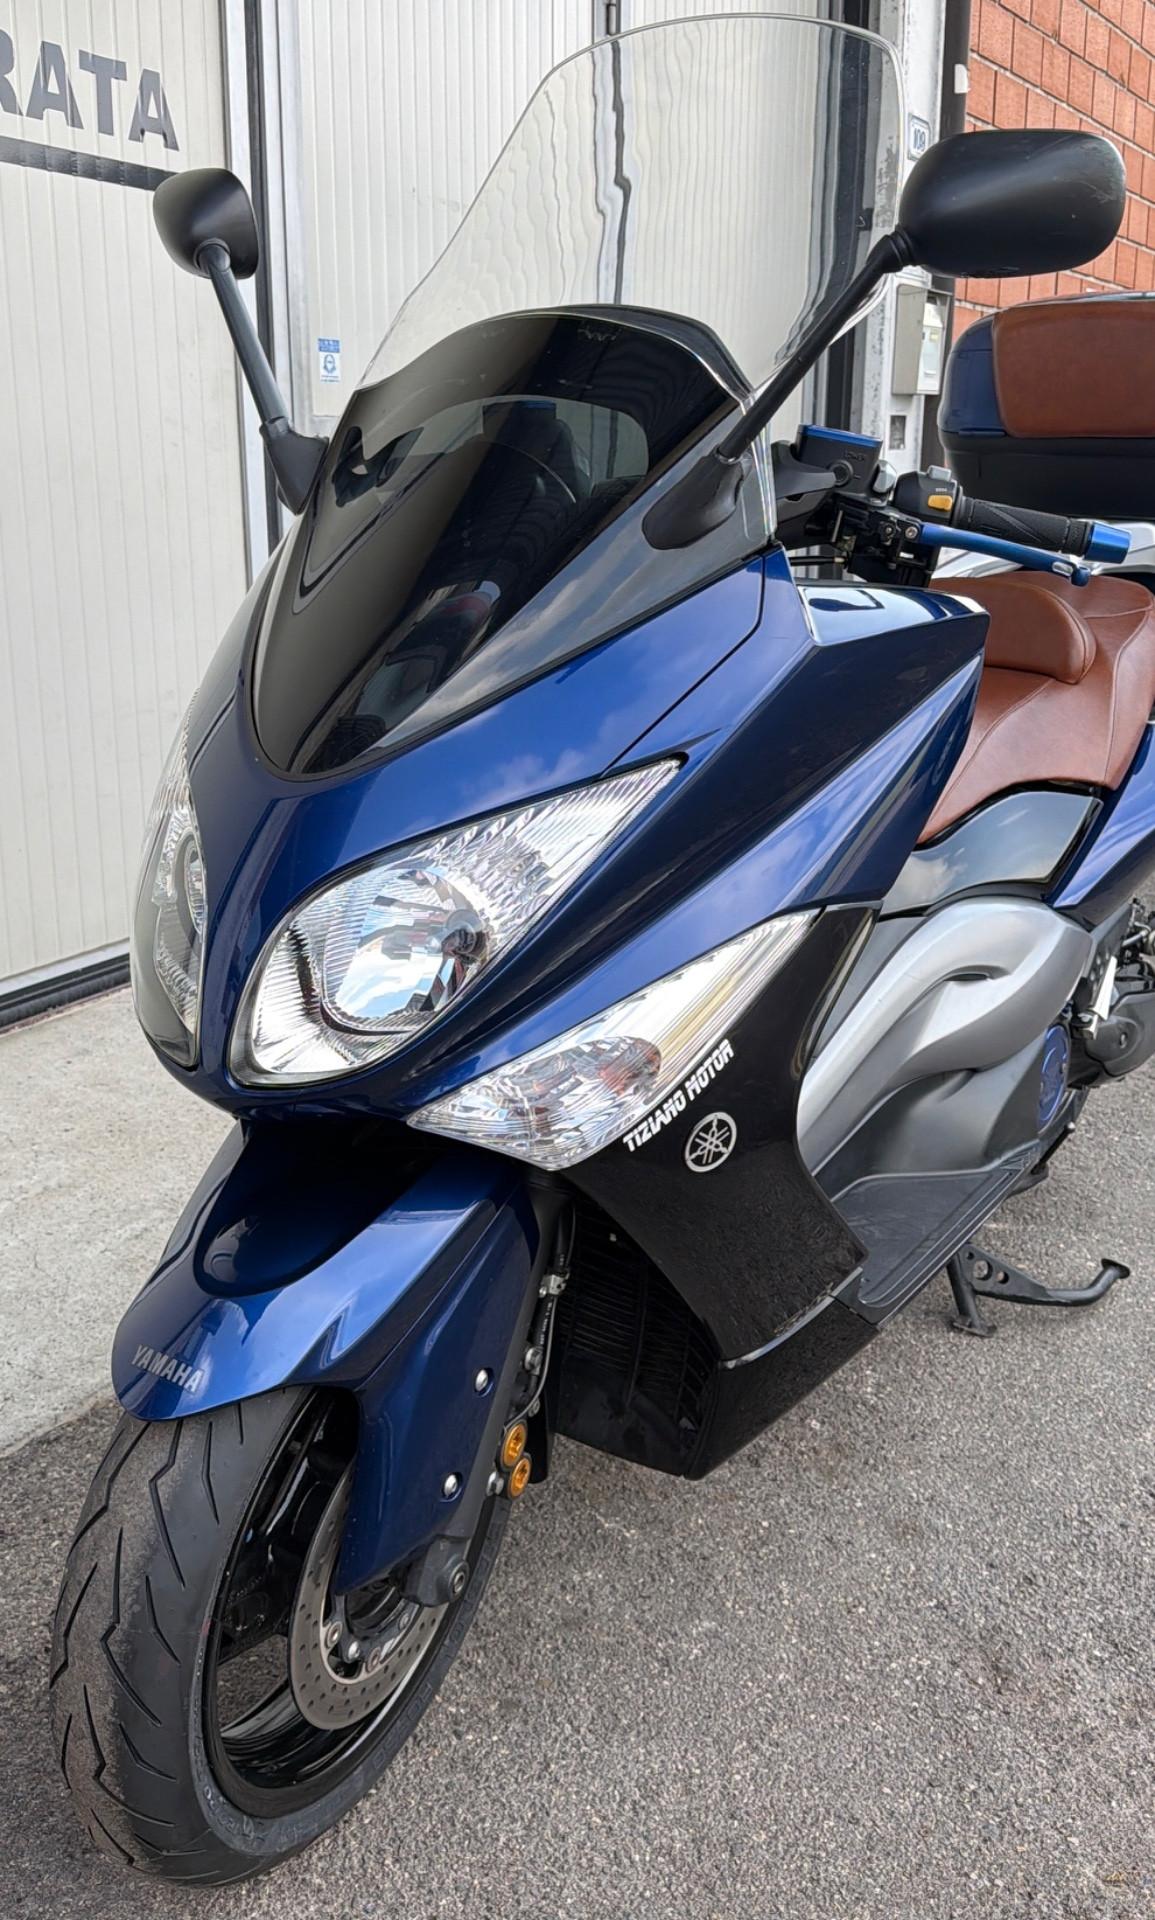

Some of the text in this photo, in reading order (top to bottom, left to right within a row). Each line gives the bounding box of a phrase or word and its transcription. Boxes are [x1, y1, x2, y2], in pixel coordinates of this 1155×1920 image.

[622, 1038, 735, 1152] TIZIANO MOTOR
[131, 1344, 204, 1393] YAMAHA
